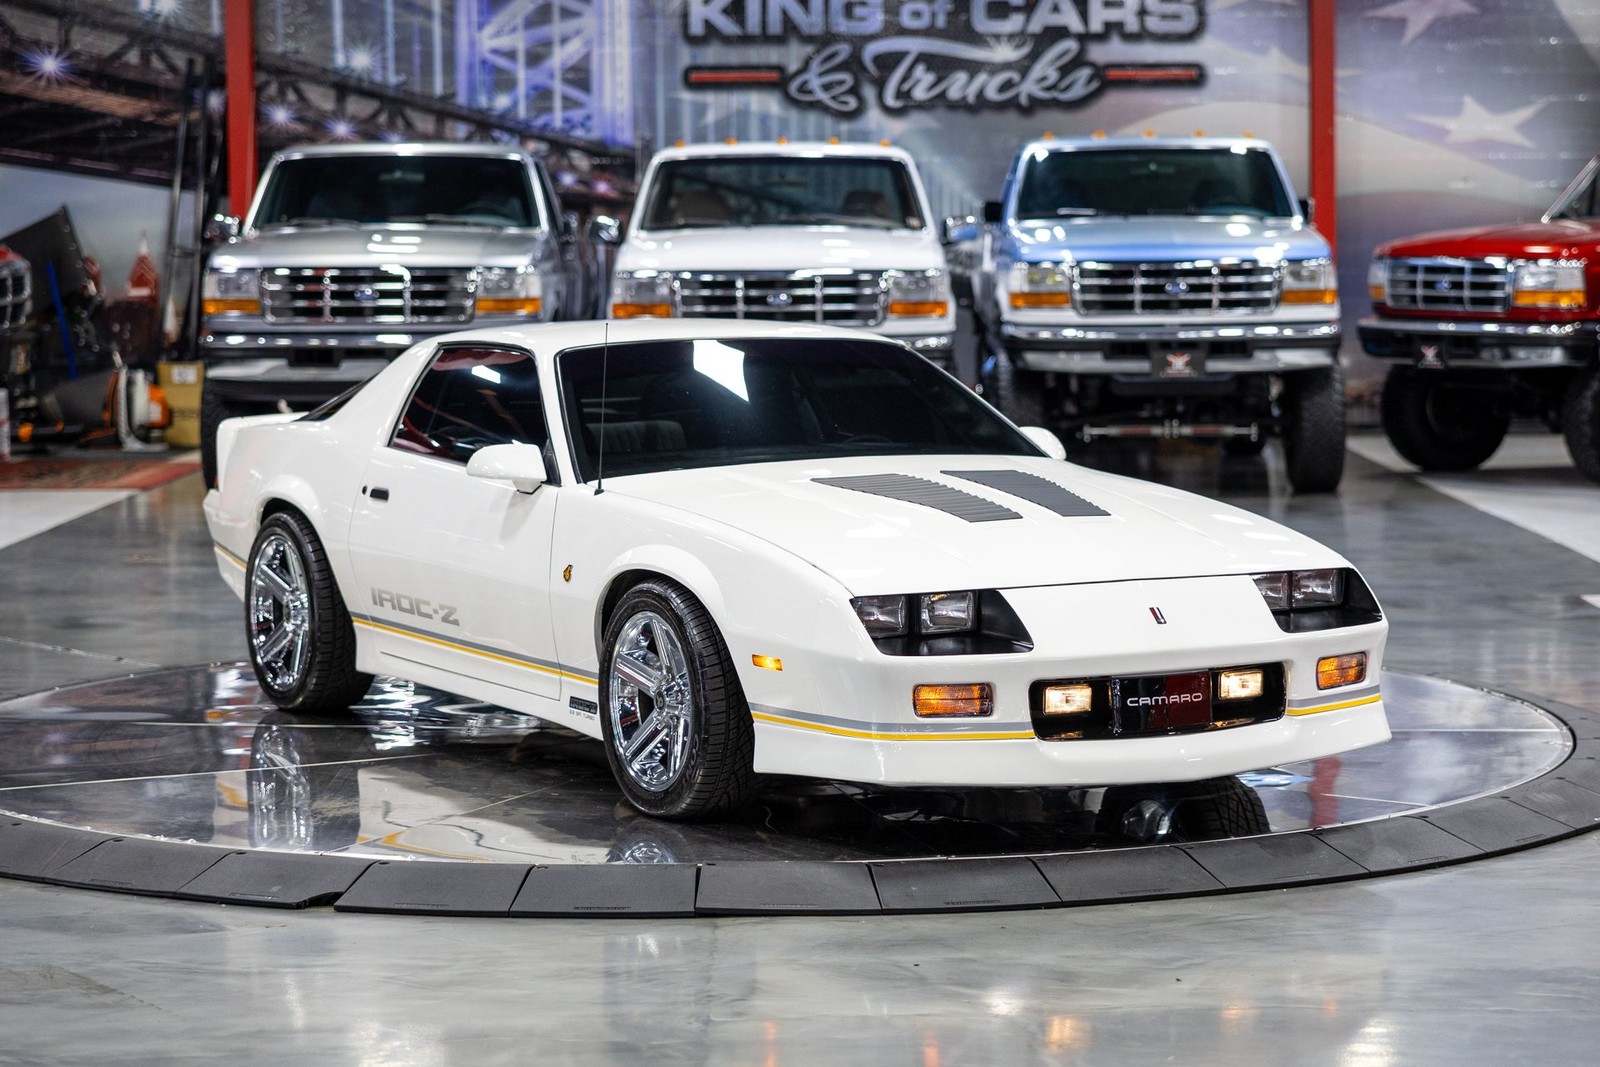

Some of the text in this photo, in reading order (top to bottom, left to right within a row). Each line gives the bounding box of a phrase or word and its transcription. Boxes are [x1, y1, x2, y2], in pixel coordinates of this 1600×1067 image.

[688, 0, 1199, 36] KING of CARS
[787, 36, 1101, 111] & Trucks
[371, 586, 461, 627] IROC-Z
[1127, 692, 1203, 707] CAMARO
